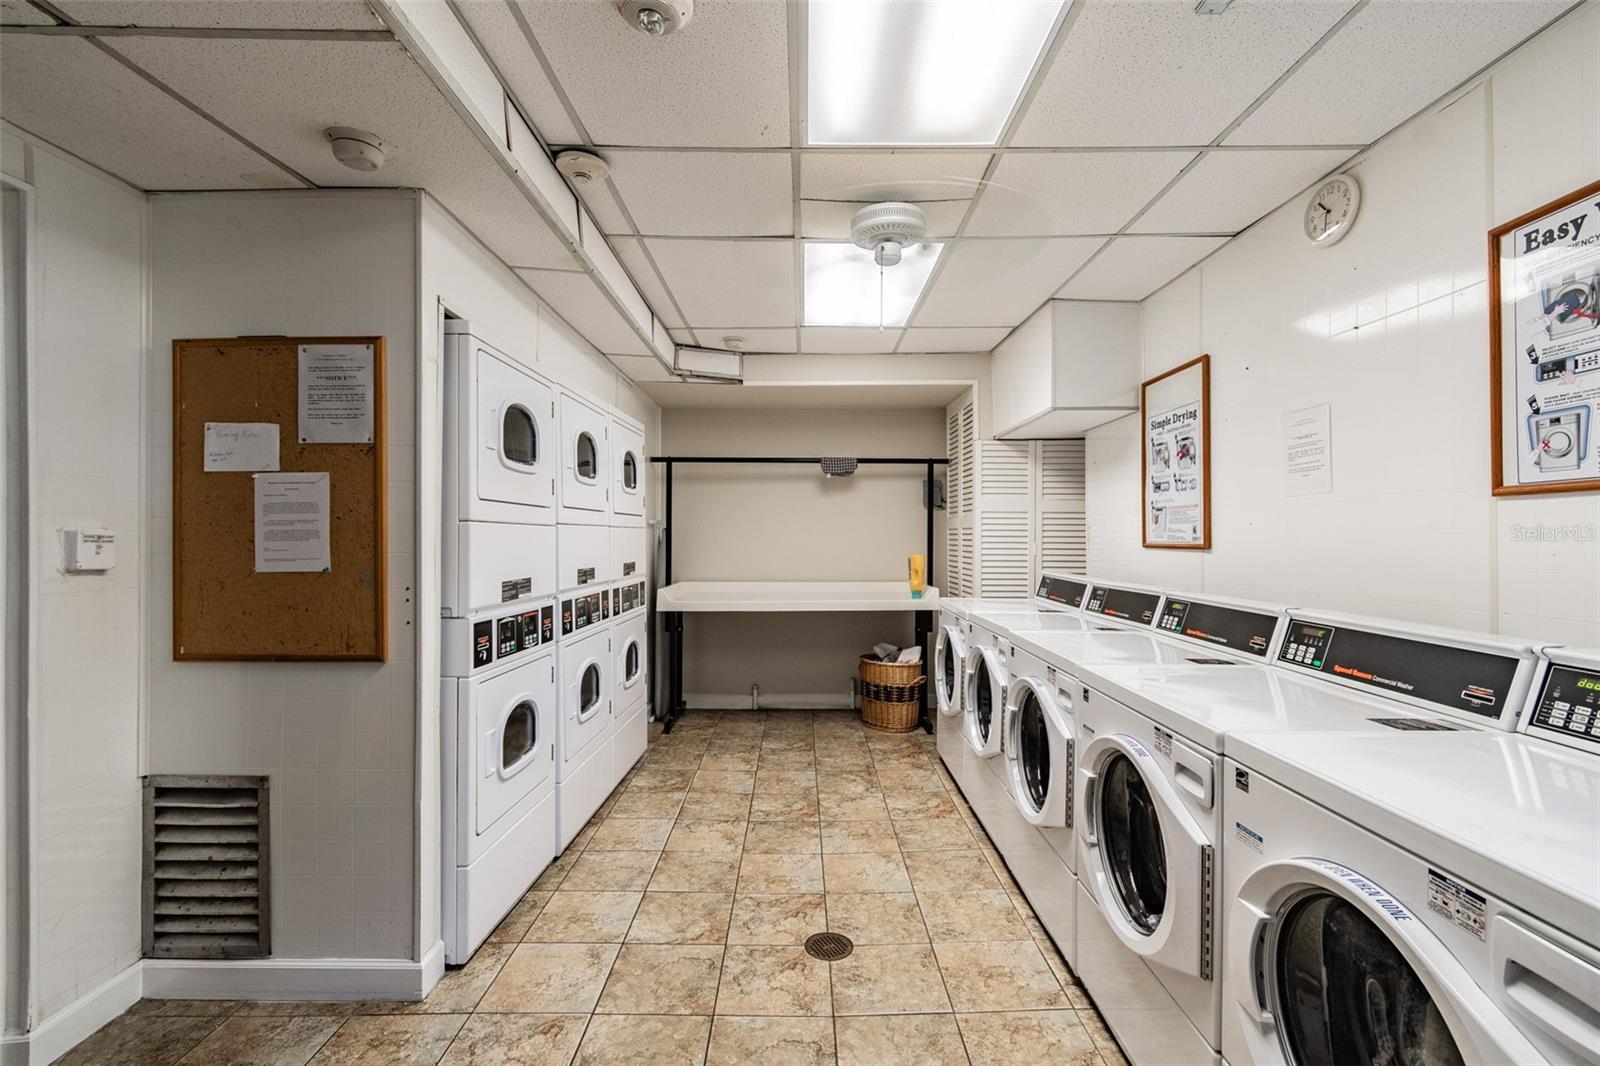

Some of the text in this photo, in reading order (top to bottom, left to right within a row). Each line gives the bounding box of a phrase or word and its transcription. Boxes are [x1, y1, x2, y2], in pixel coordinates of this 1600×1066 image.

[1523, 213, 1588, 254] Easy
[1530, 351, 1536, 360] 3
[1532, 402, 1538, 410] 5
[1151, 416, 1171, 430] Simple
[1172, 409, 1198, 423] Drying
[1334, 664, 1353, 675] Speed
[1348, 878, 1384, 897] WHEN
[1376, 898, 1412, 922] DONE
